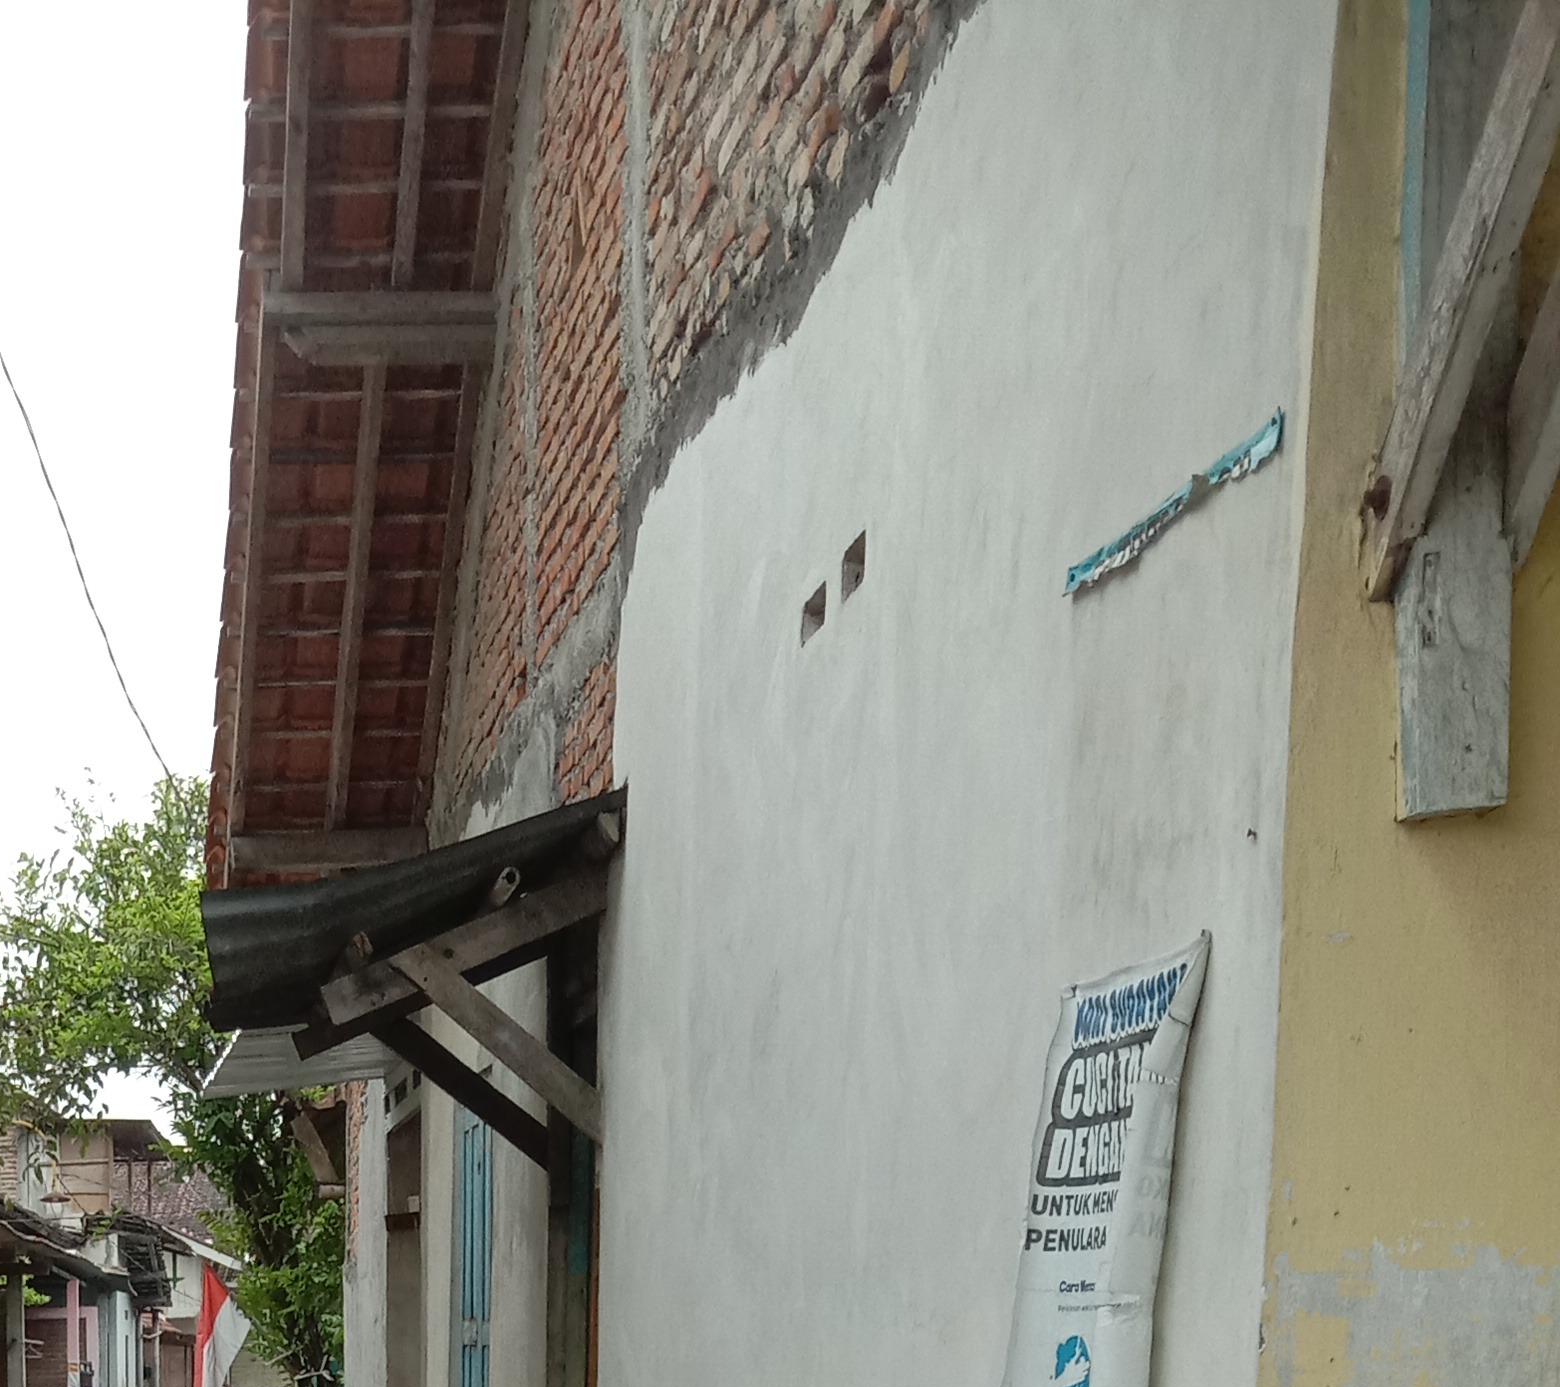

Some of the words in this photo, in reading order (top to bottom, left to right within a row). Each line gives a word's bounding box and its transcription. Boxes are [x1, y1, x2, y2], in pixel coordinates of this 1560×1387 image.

[1032, 1193, 1092, 1216] UNTUK
[1092, 1190, 1119, 1214] MEN
[1025, 1226, 1107, 1252] PENULARA
